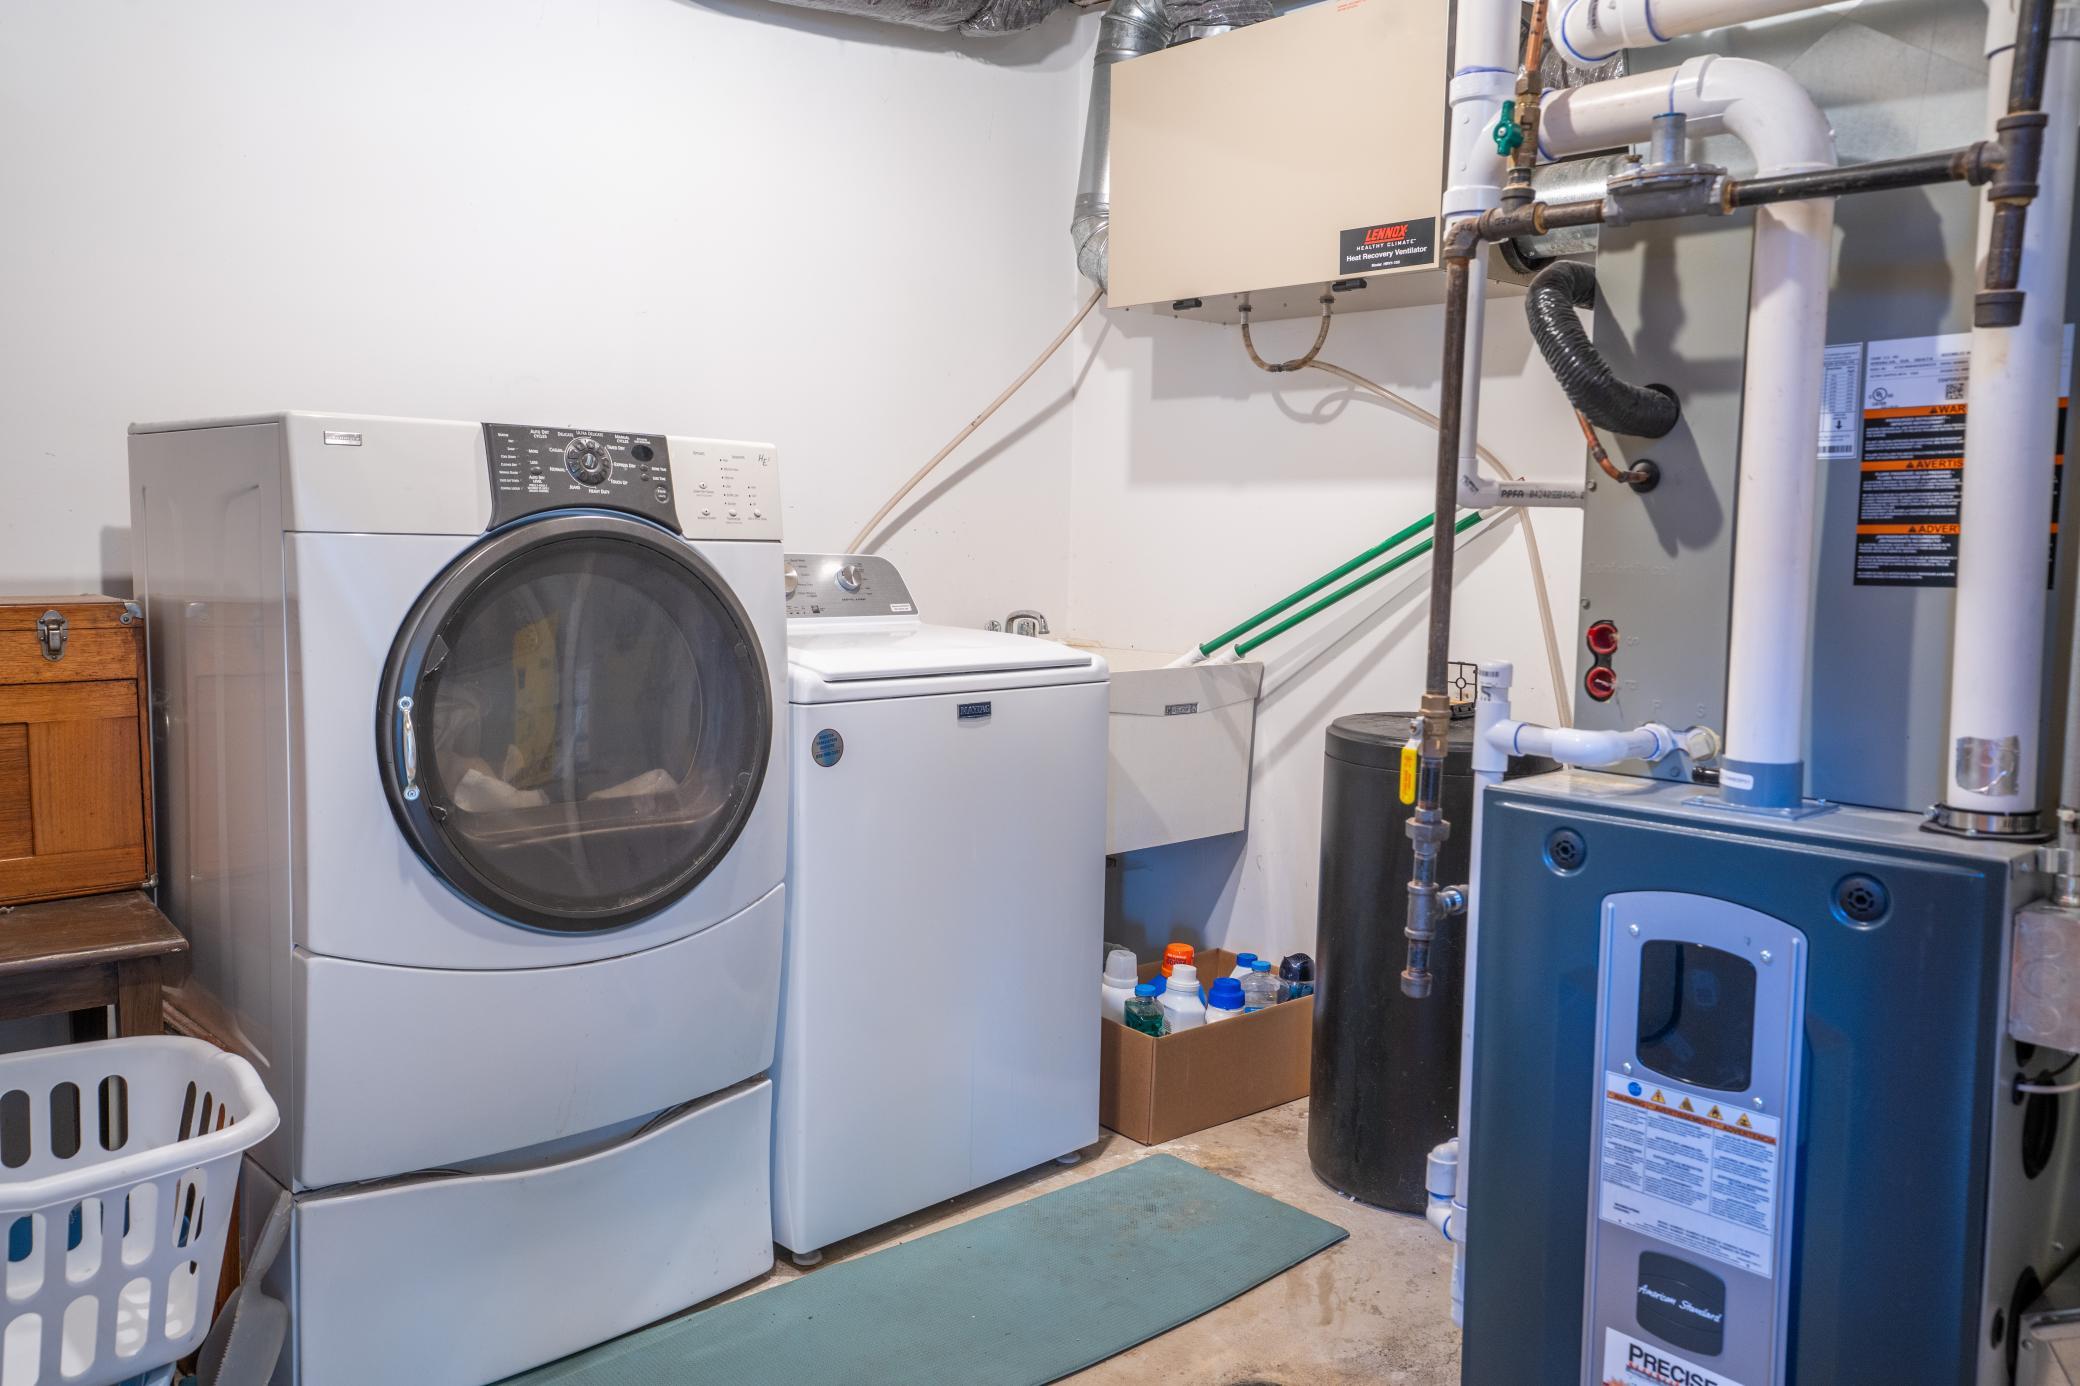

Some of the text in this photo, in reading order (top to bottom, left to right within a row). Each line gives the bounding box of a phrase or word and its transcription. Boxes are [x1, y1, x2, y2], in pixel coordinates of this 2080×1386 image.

[1366, 224, 1408, 241] LENNOX
[1346, 246, 1428, 263] Heat Recovery Ventilator
[1356, 243, 1385, 251] HEALTHY
[1637, 1284, 1722, 1323] American Standard
